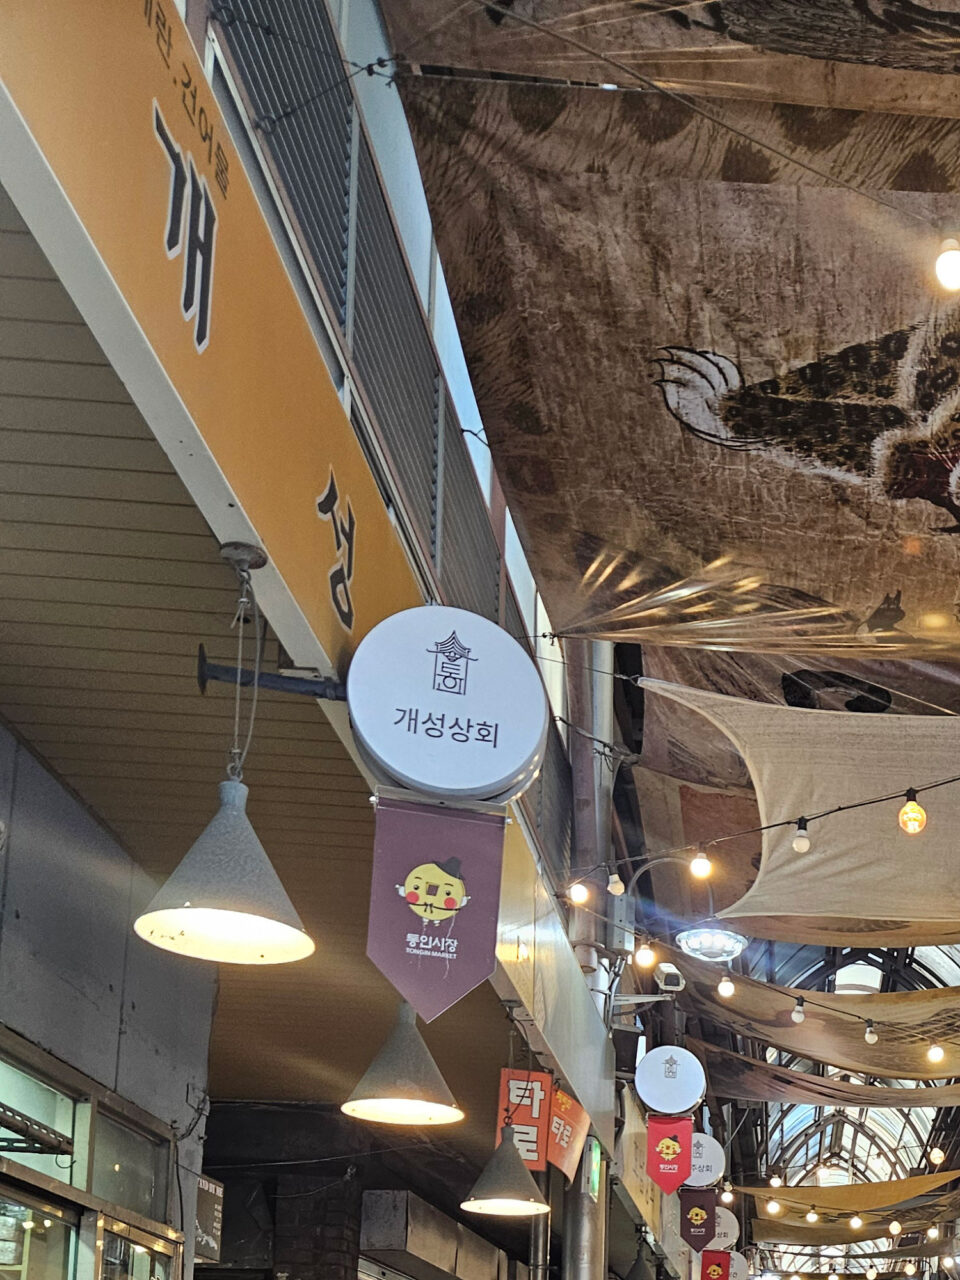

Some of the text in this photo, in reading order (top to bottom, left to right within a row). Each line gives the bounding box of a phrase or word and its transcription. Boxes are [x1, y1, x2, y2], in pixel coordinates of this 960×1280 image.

[394, 707, 499, 749] 개성상회
[405, 933, 459, 953] 통인시장
[405, 947, 457, 959] TONGIN MARKET
[508, 1079, 545, 1161] 타로
[551, 1115, 573, 1148] 타로
